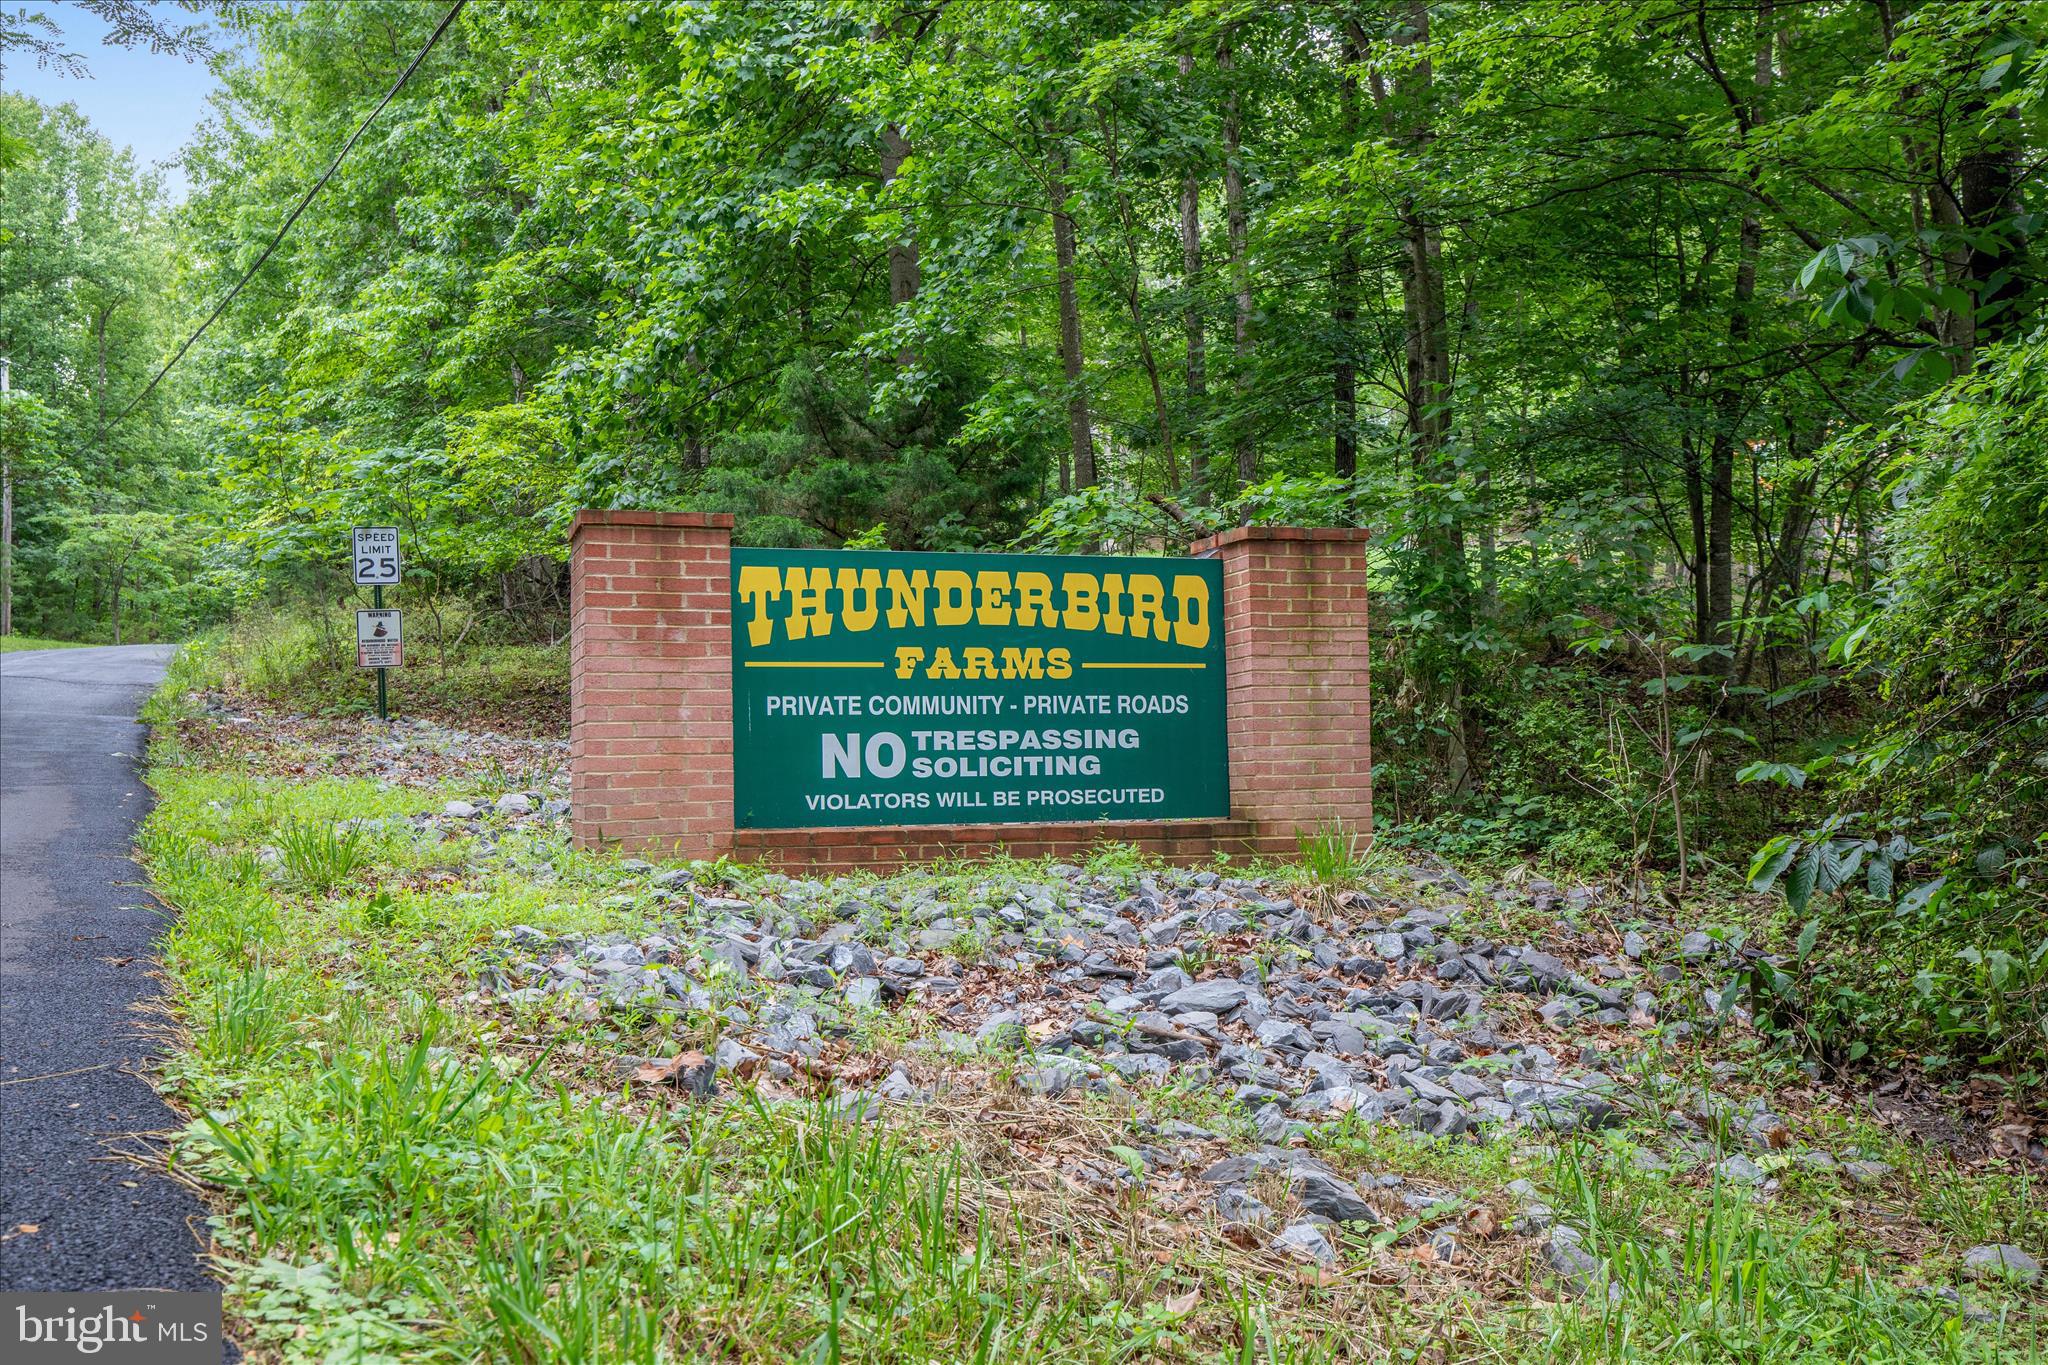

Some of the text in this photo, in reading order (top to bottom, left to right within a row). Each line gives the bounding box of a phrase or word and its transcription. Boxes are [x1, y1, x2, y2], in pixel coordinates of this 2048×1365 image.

[357, 533, 395, 542] SPEED
[361, 545, 392, 554] LIMIT
[358, 557, 397, 578] 25
[738, 566, 1211, 649] THUNDERBIRD
[894, 646, 1073, 680] FARMS
[766, 695, 863, 716] PRIVATE
[867, 695, 1005, 716] COMMUNITY
[1023, 694, 1112, 715] PRIVATE
[1117, 694, 1190, 715] ROADS
[911, 728, 1140, 751] TRESPASSING
[821, 731, 907, 779] NO
[911, 754, 1101, 778] SOLICITING
[805, 787, 1166, 811] VIOLATORS WILL BE PROSECUTED
